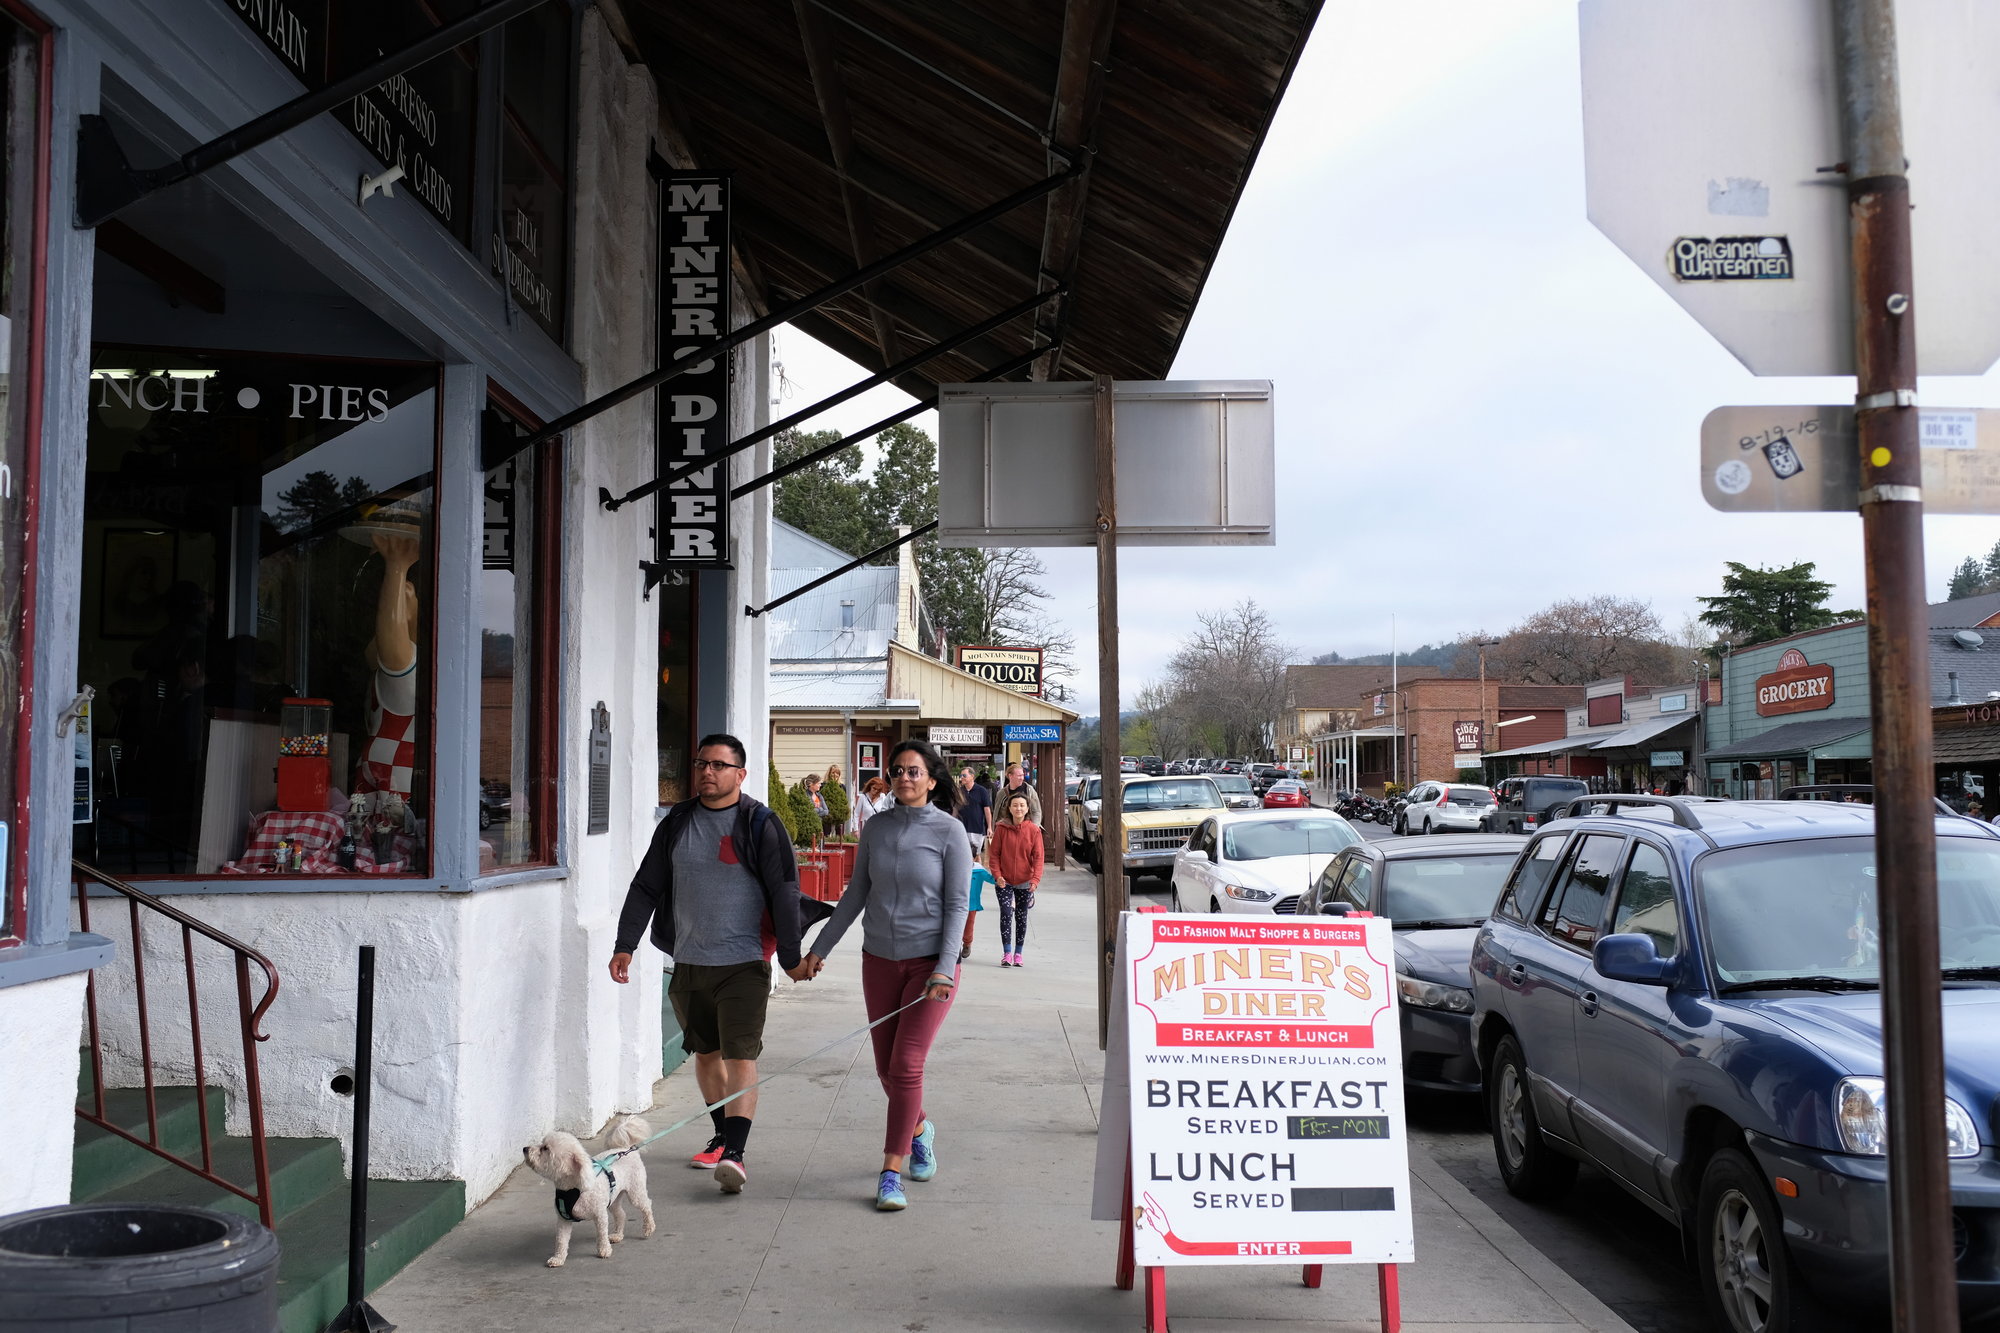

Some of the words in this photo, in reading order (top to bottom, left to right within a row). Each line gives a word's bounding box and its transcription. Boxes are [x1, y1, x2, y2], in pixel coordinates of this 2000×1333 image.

[236, 0, 307, 74] NTAIN
[354, 93, 391, 161] GIFTS
[397, 134, 408, 180] &
[415, 152, 452, 221] CARDS
[516, 207, 537, 258] FILM
[1677, 239, 1786, 259] ORIGINAL
[1681, 258, 1788, 276] WATERMEN
[540, 281, 552, 323] RX
[288, 383, 390, 423] PIES
[1738, 419, 1823, 451] 8-19-15
[669, 394, 719, 557] DINER
[967, 652, 1006, 660] MOUNTAIN
[1008, 653, 1035, 662] SPIRITS
[1783, 653, 1800, 670] JACK'S
[1759, 676, 1829, 705] GROCERY
[931, 734, 948, 742] PIES
[950, 734, 957, 742] &
[957, 734, 983, 742] LUNCH
[1040, 729, 1058, 738] SPA
[1455, 725, 1479, 736] CIDER
[1457, 735, 1478, 744] MILL
[1158, 926, 1181, 938] OLD
[1183, 926, 1226, 939] FASHION
[1230, 927, 1256, 939] MALT
[1259, 927, 1300, 940] SHOPPE
[1303, 929, 1311, 940] &
[1313, 929, 1361, 941] BURGERS
[1153, 947, 1372, 1002] MINER'S
[1203, 992, 1326, 1017] DINER
[1182, 1028, 1272, 1042] BREAKFAST
[1279, 1029, 1290, 1042] &
[1296, 1029, 1348, 1043] LUNCH
[1147, 1080, 1388, 1109] BREAKFAST
[1188, 1117, 1278, 1134] SERVED
[1150, 1153, 1296, 1182] LUNCH
[1193, 1192, 1285, 1209] SERVED
[1237, 1242, 1301, 1256] ENTER
